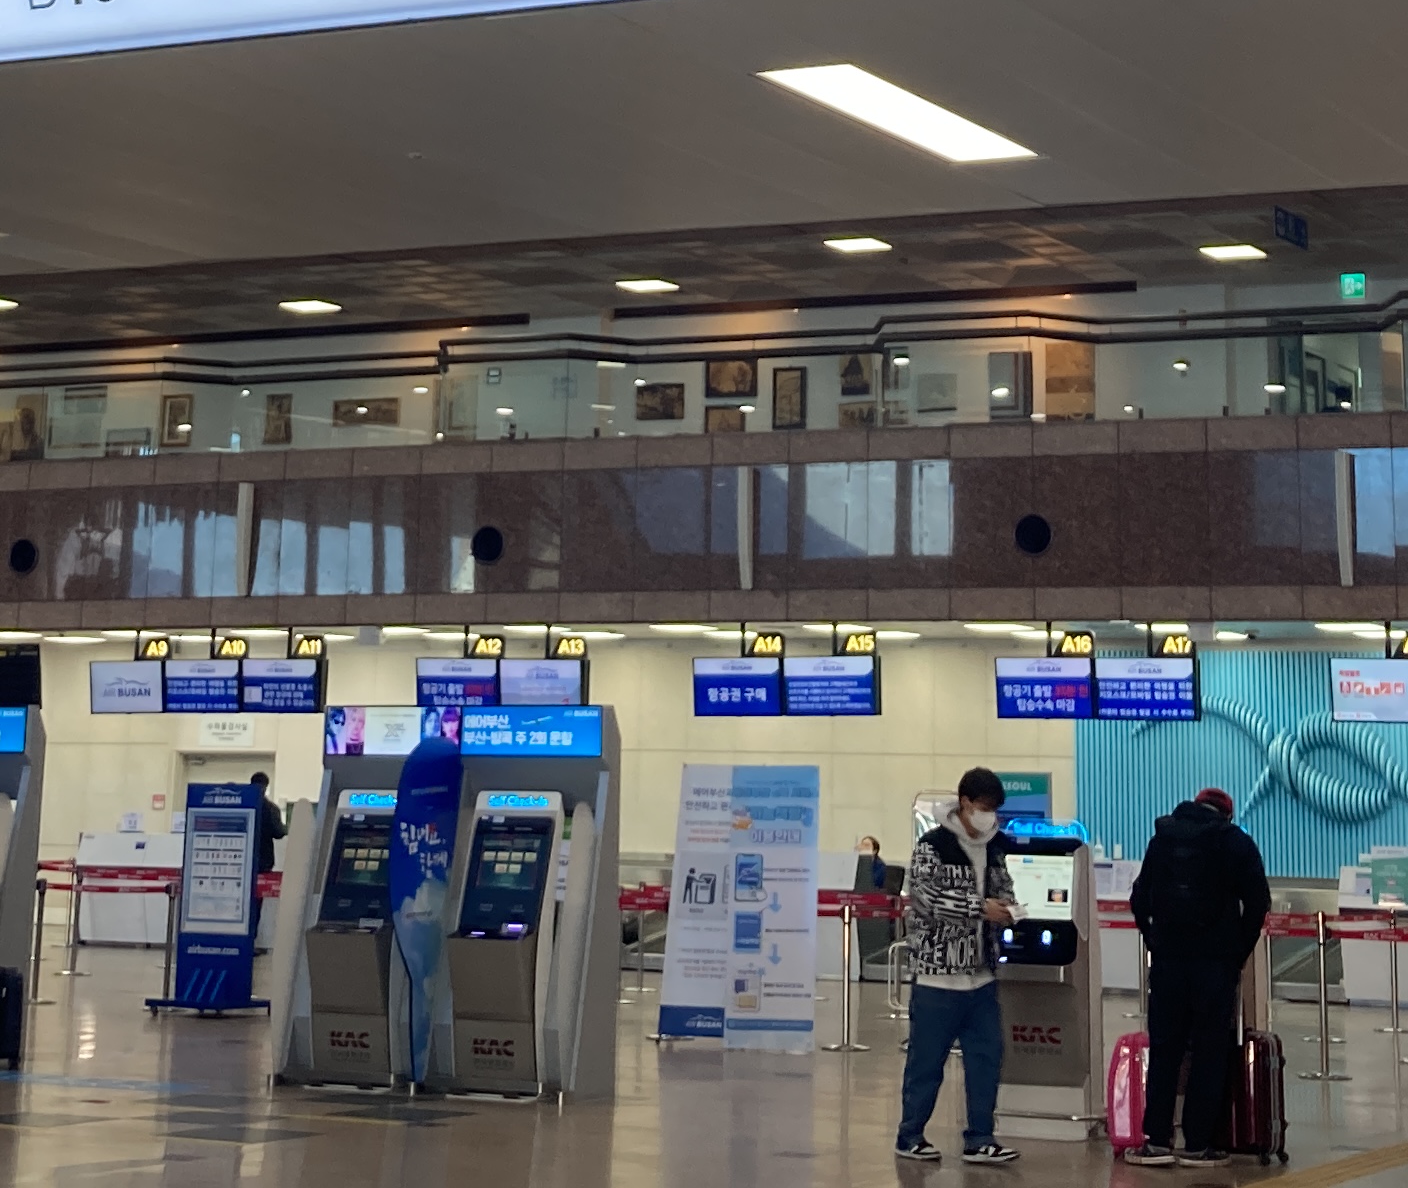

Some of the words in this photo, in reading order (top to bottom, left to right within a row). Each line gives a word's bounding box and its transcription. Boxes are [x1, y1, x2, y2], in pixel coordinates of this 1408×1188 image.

[146, 640, 168, 657] A9
[220, 639, 246, 655] A10
[298, 639, 322, 655] A11
[475, 638, 502, 654] A12
[557, 638, 585, 655] A13
[753, 635, 782, 652] A14
[845, 634, 874, 651] A15
[1061, 635, 1092, 653] A16
[1163, 636, 1192, 654] A17
[118, 687, 151, 697] BUSAN
[215, 796, 242, 805] BUSAN
[330, 1030, 370, 1048] KAC
[1013, 1025, 1061, 1044] KAC
[473, 1038, 514, 1057] KAC
